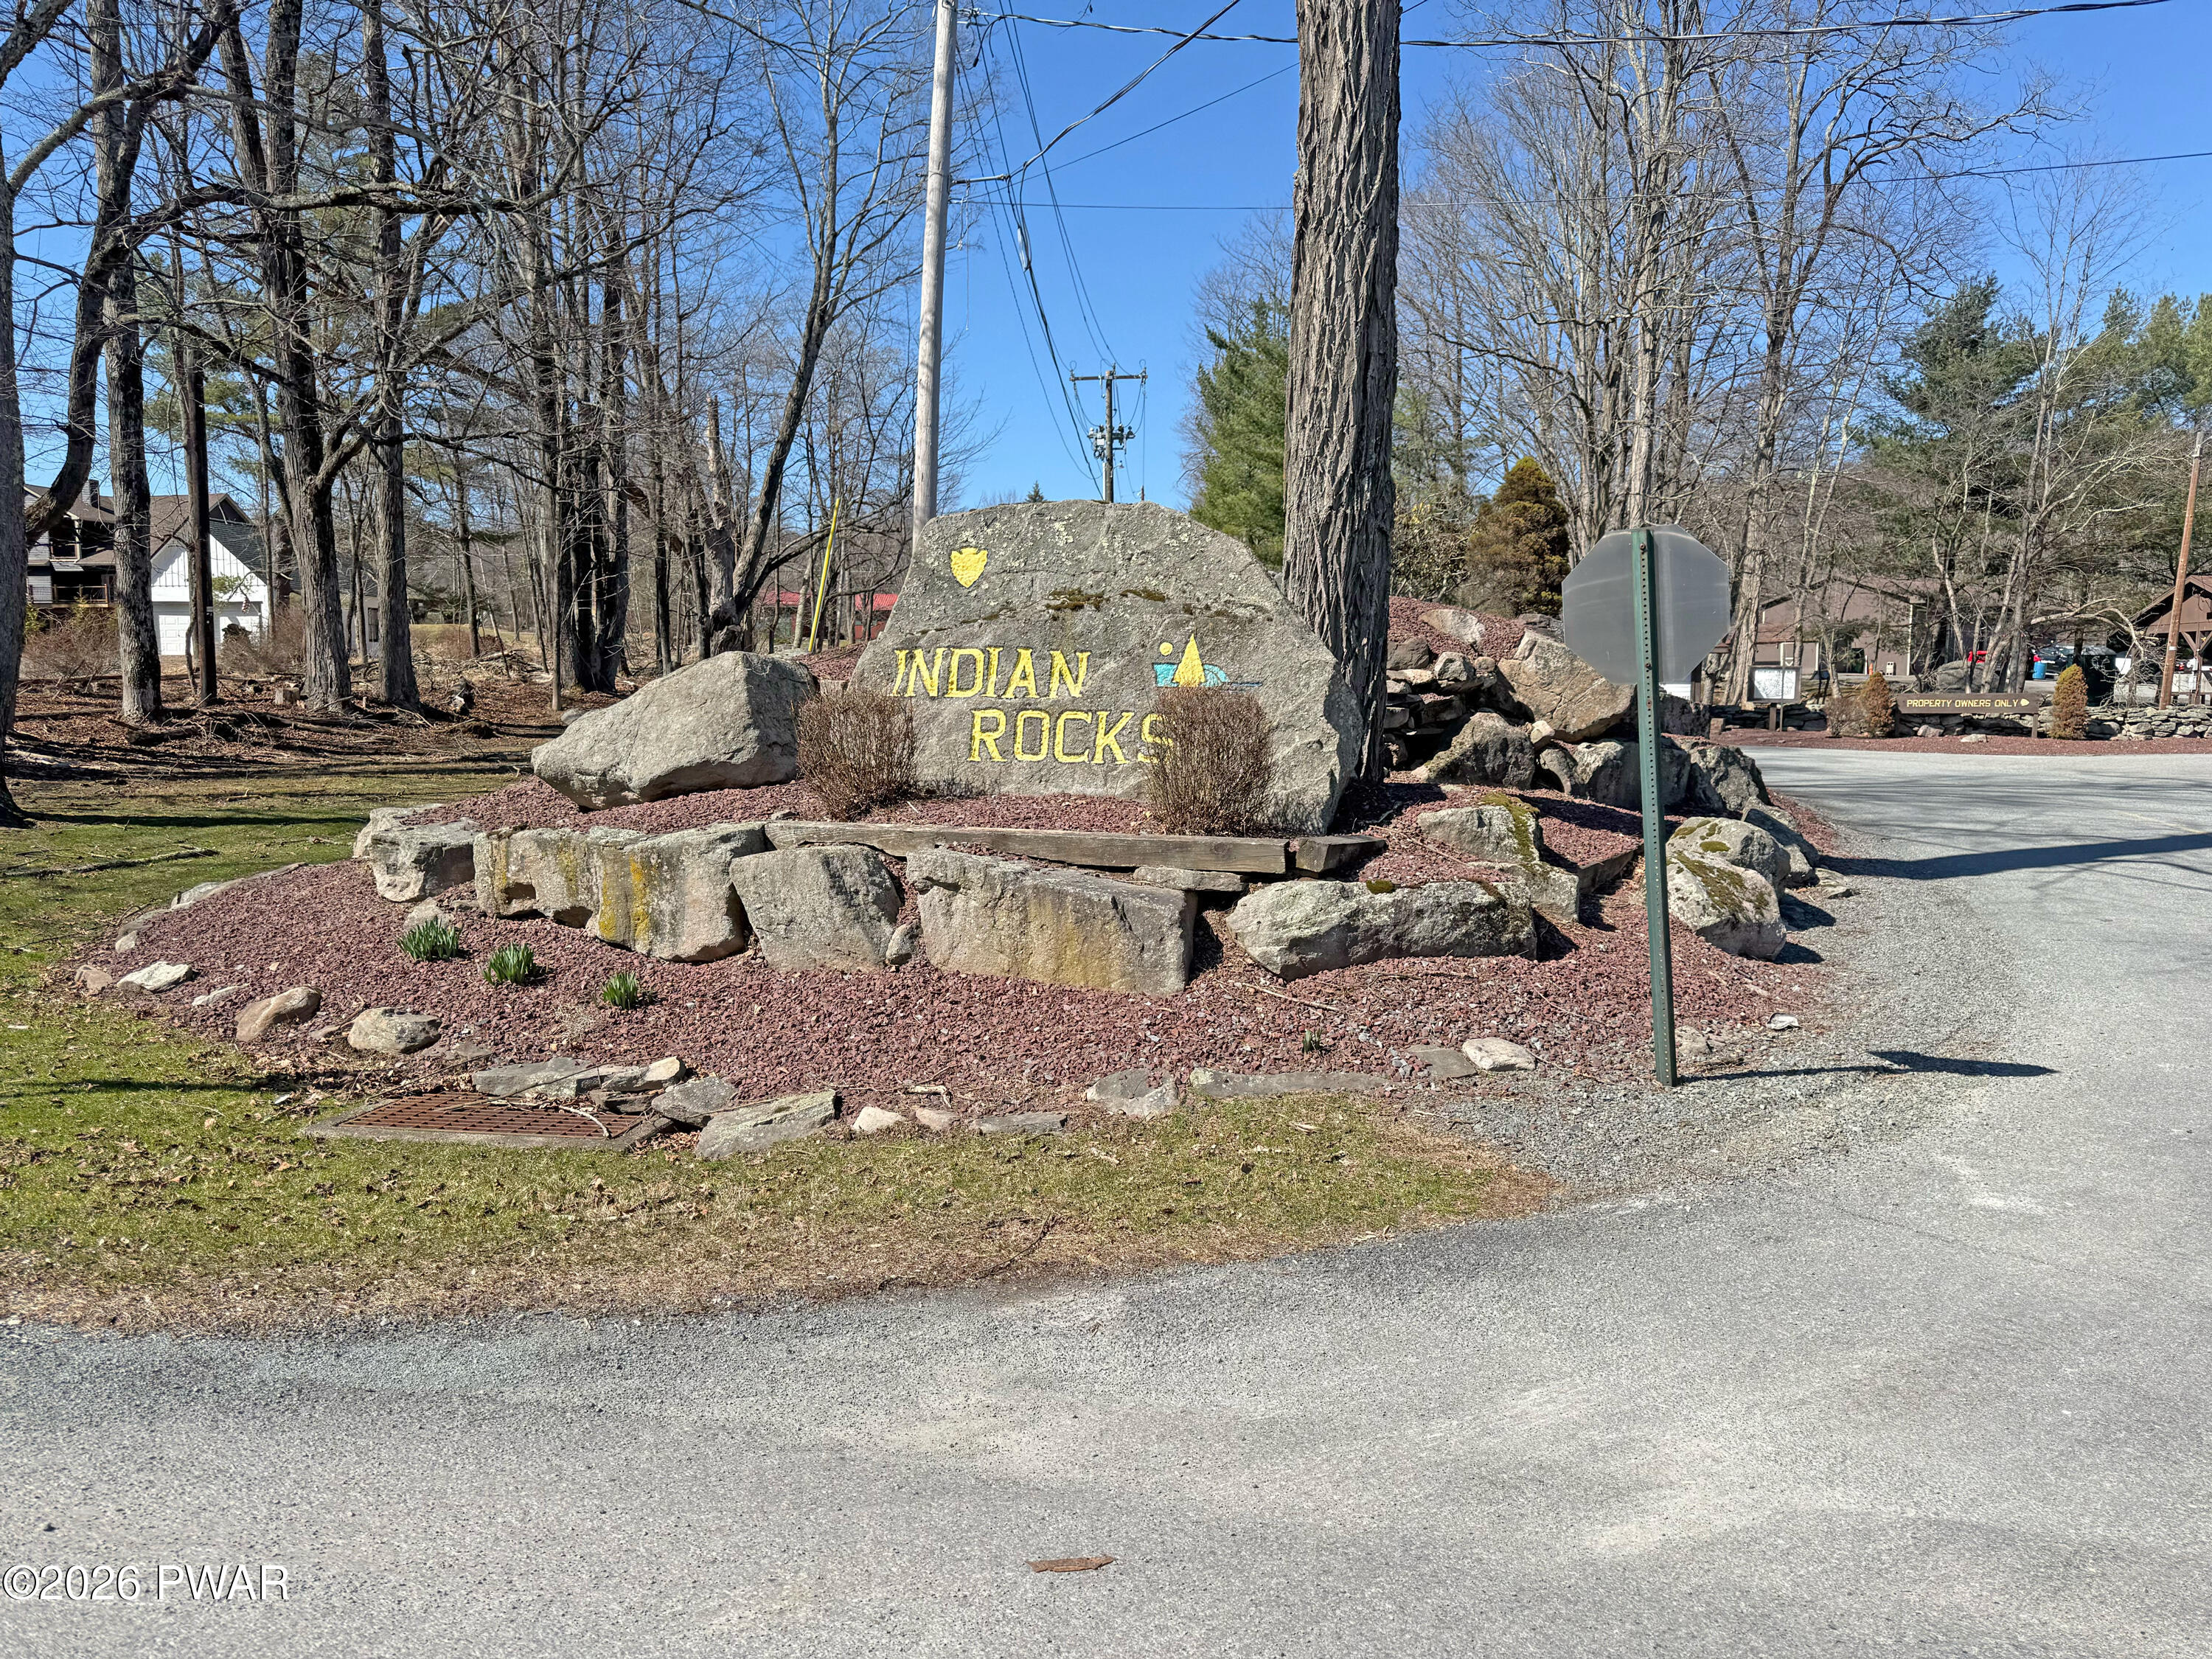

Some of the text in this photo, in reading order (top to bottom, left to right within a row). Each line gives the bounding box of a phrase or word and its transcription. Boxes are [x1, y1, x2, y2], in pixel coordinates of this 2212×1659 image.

[887, 646, 1091, 699] INDIAN
[1906, 699, 2019, 708] PROPERTY OWNERS ONLY
[967, 709, 1175, 765] ROCKS
